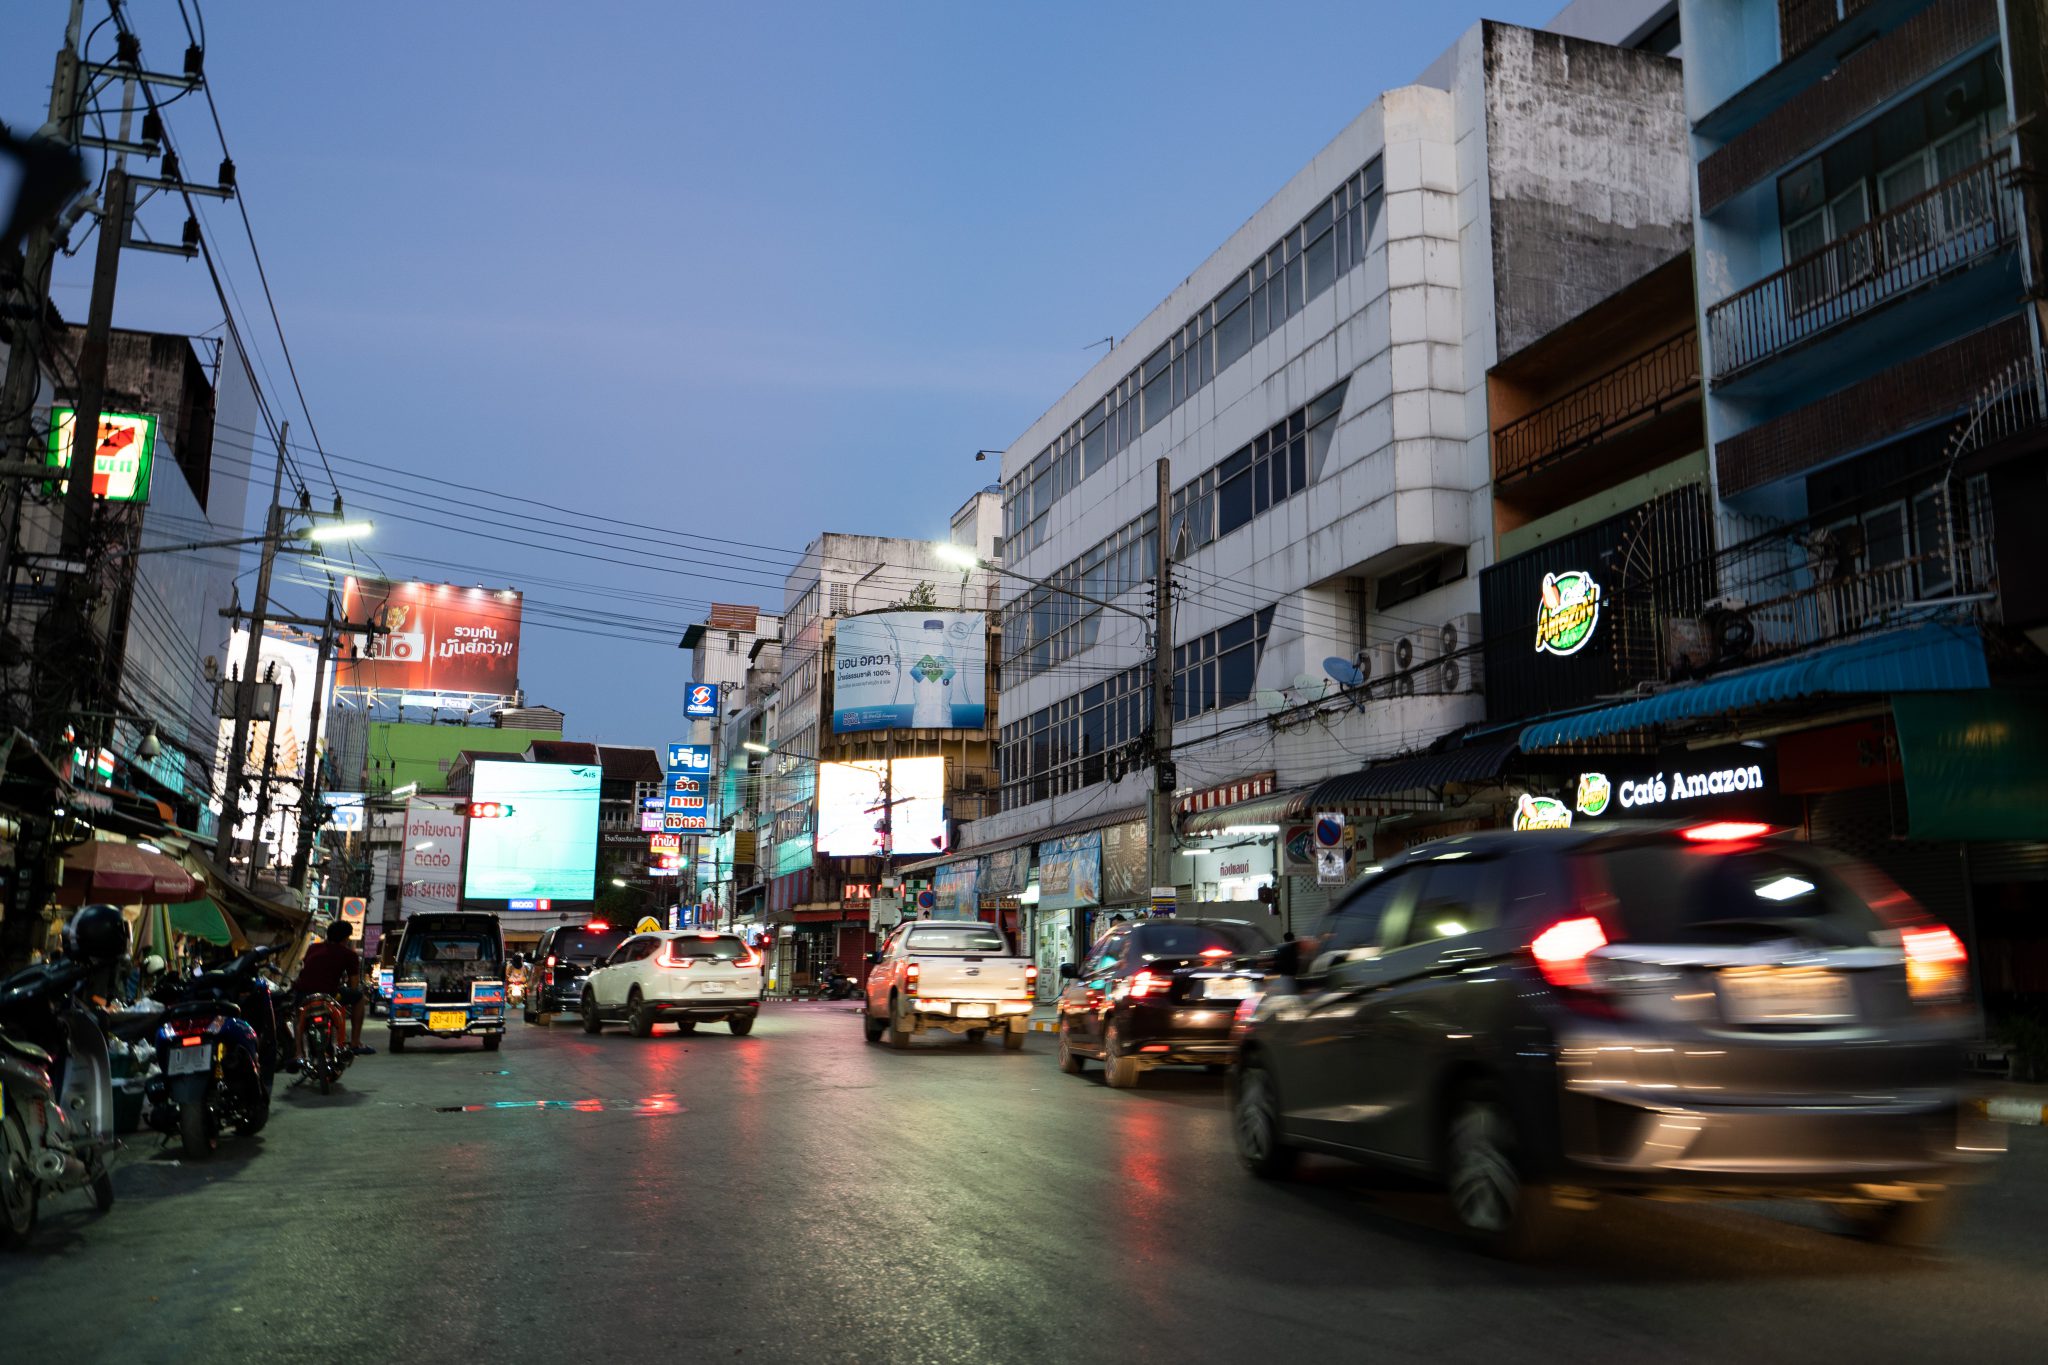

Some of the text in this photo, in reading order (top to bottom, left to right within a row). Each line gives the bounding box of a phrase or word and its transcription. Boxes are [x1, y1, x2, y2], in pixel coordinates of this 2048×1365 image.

[454, 625, 497, 638] รวมกัน
[838, 654, 891, 670] บอน อควา
[873, 669, 891, 677] 100%
[669, 747, 709, 769] เจีย
[583, 771, 597, 779] AIS
[675, 776, 700, 791] อัด
[1619, 771, 1667, 808] Café
[1670, 765, 1763, 800] Amazon
[669, 796, 704, 809] ภาพ
[408, 820, 462, 837] เช่าโฆษณา
[665, 813, 707, 829] ดิจิตอล
[651, 833, 680, 847] ทำฟัน
[414, 848, 451, 867] ติดต่อ
[403, 882, 457, 898] 081-5414180
[845, 884, 871, 899] PK
